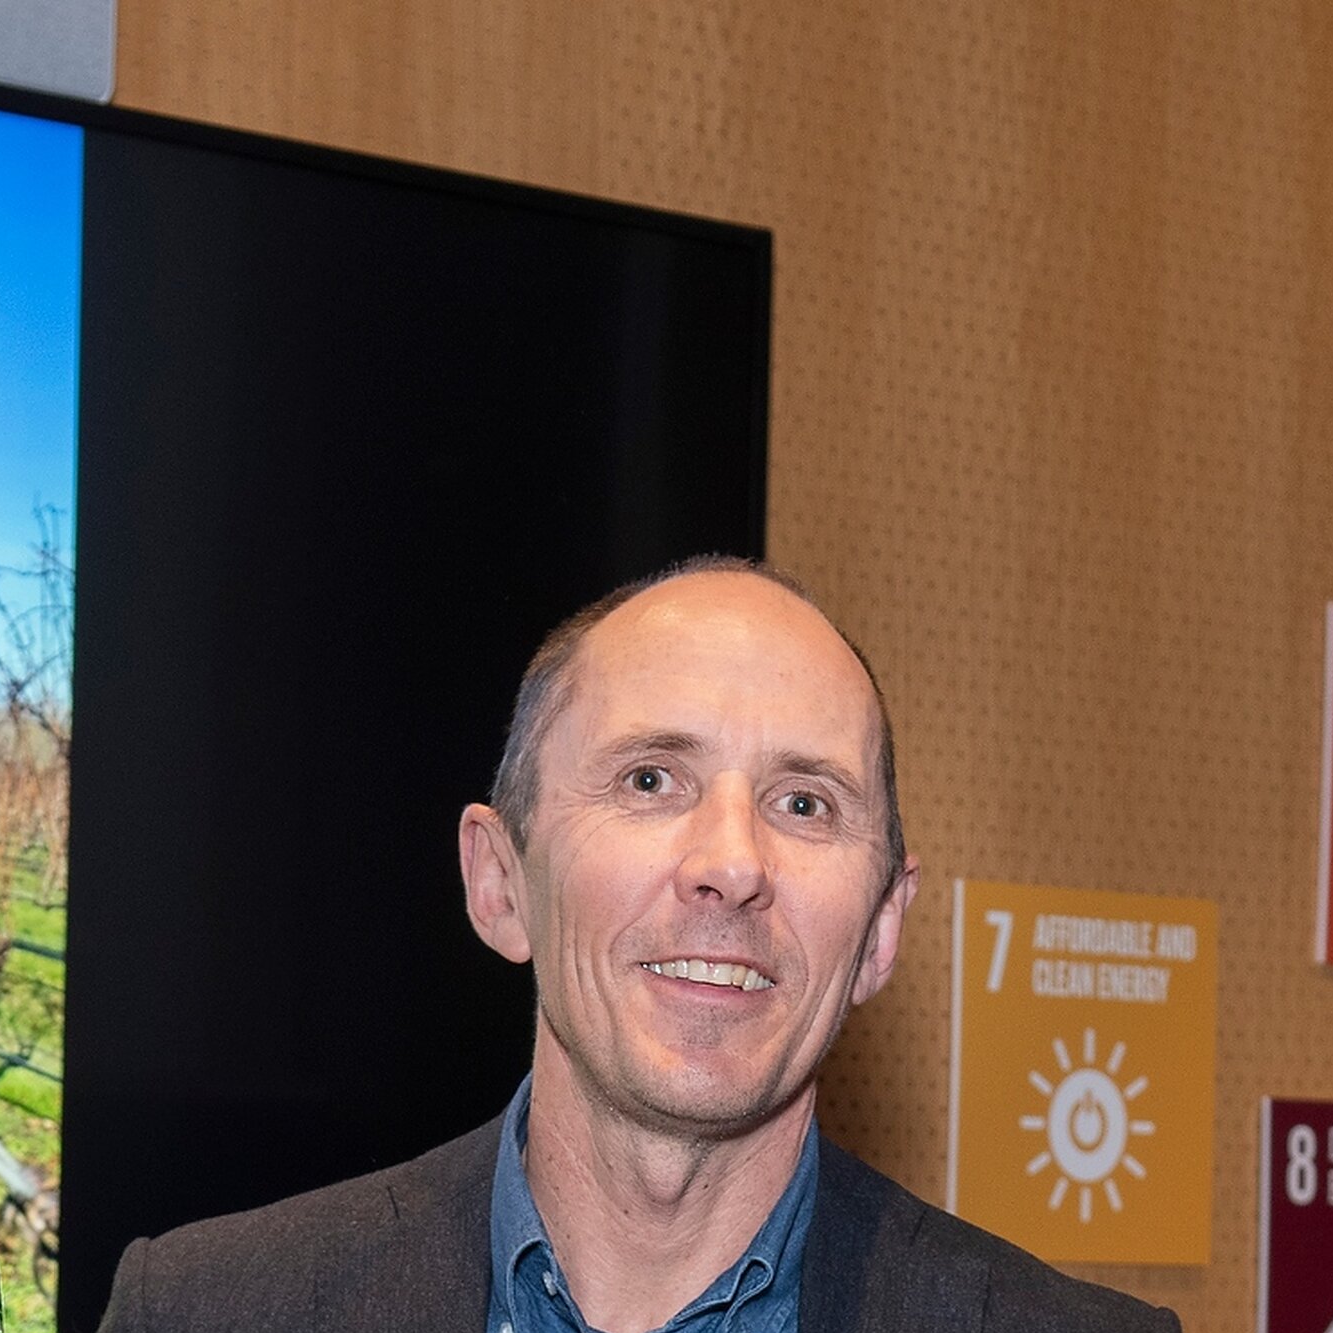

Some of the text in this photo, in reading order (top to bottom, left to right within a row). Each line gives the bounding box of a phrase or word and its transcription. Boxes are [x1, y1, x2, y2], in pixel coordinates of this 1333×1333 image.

[984, 909, 1013, 993] 7
[1032, 913, 1198, 963] AFFORDABLE AND
[1031, 958, 1171, 1004] CLEAN ENERGY
[1286, 1124, 1317, 1206] 8
